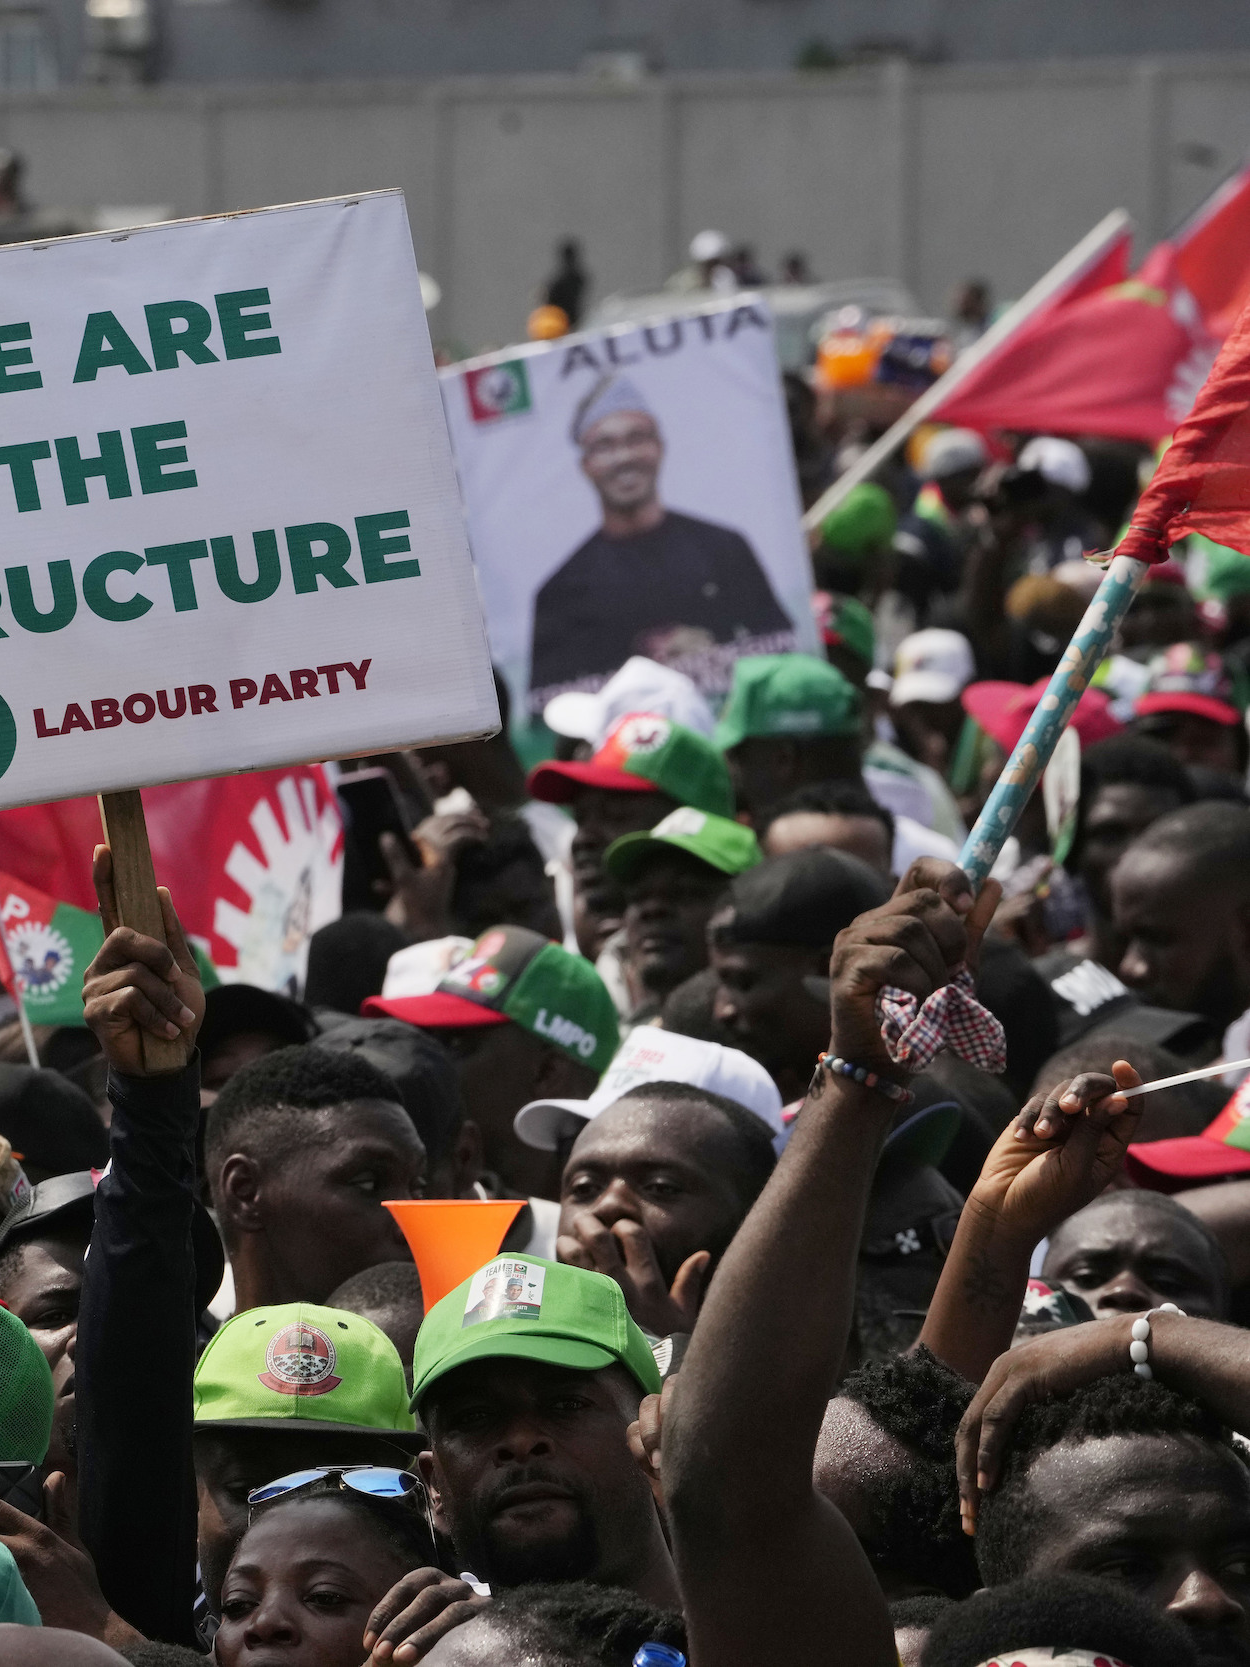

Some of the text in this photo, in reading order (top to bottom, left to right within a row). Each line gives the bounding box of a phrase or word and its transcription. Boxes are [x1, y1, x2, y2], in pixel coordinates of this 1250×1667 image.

[71, 286, 282, 384] ARE
[559, 304, 768, 380] ALUTA
[32, 658, 373, 738] LABOUR PARTY
[533, 1007, 597, 1059] LMPO
